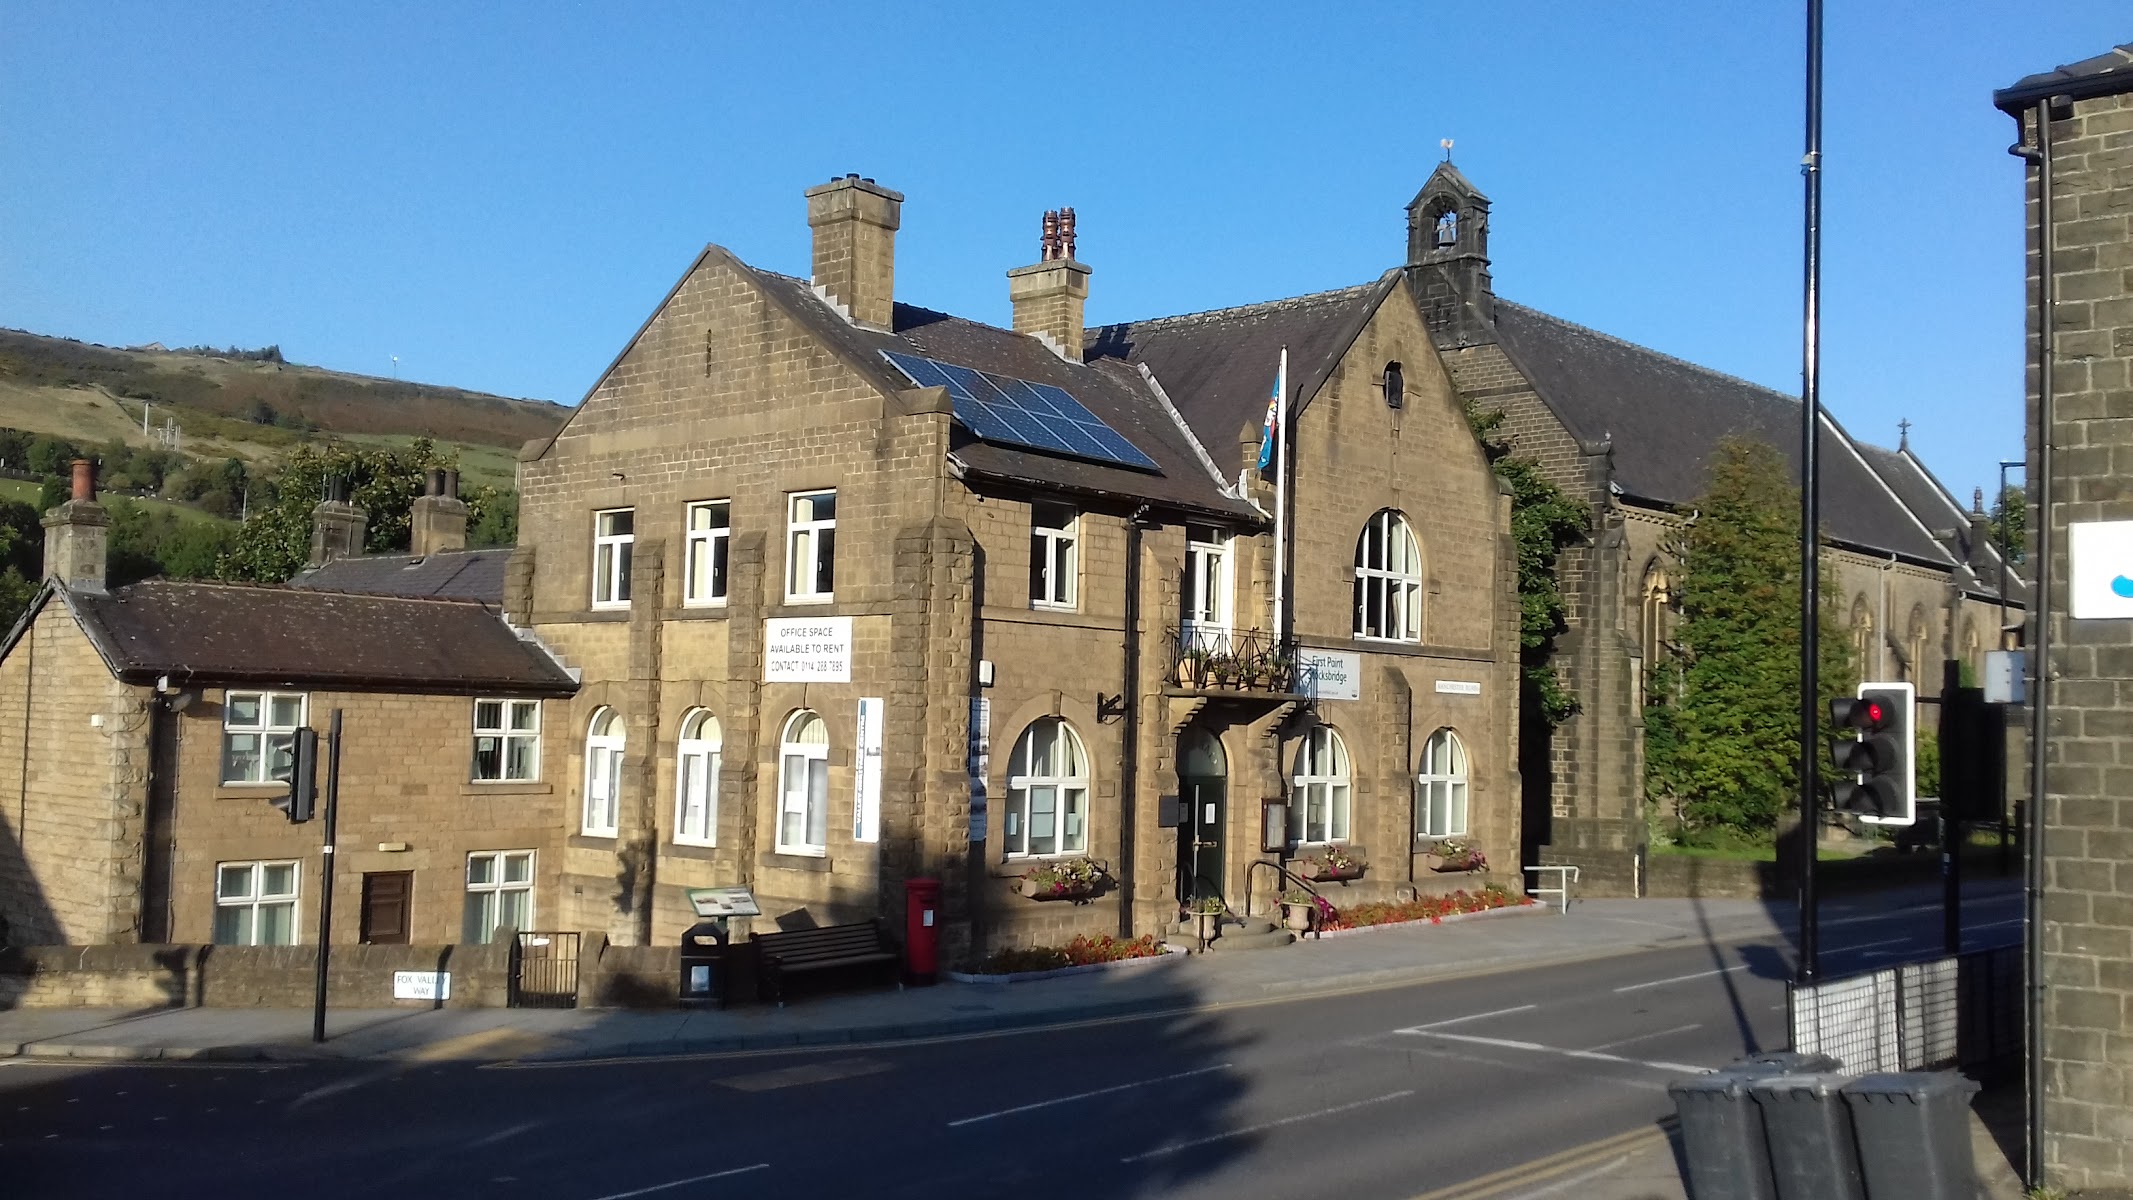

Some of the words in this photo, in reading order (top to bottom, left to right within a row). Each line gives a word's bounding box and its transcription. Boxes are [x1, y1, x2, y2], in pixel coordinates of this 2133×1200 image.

[780, 628, 807, 637] OFFICE
[809, 627, 832, 636] SPACE
[770, 644, 809, 653] AVAILABLE
[812, 644, 821, 653] TO
[823, 644, 844, 653] RENT
[771, 661, 799, 671] CONTACT
[1327, 656, 1343, 668] Point
[397, 975, 412, 983] FOX
[413, 987, 429, 995] WAY
